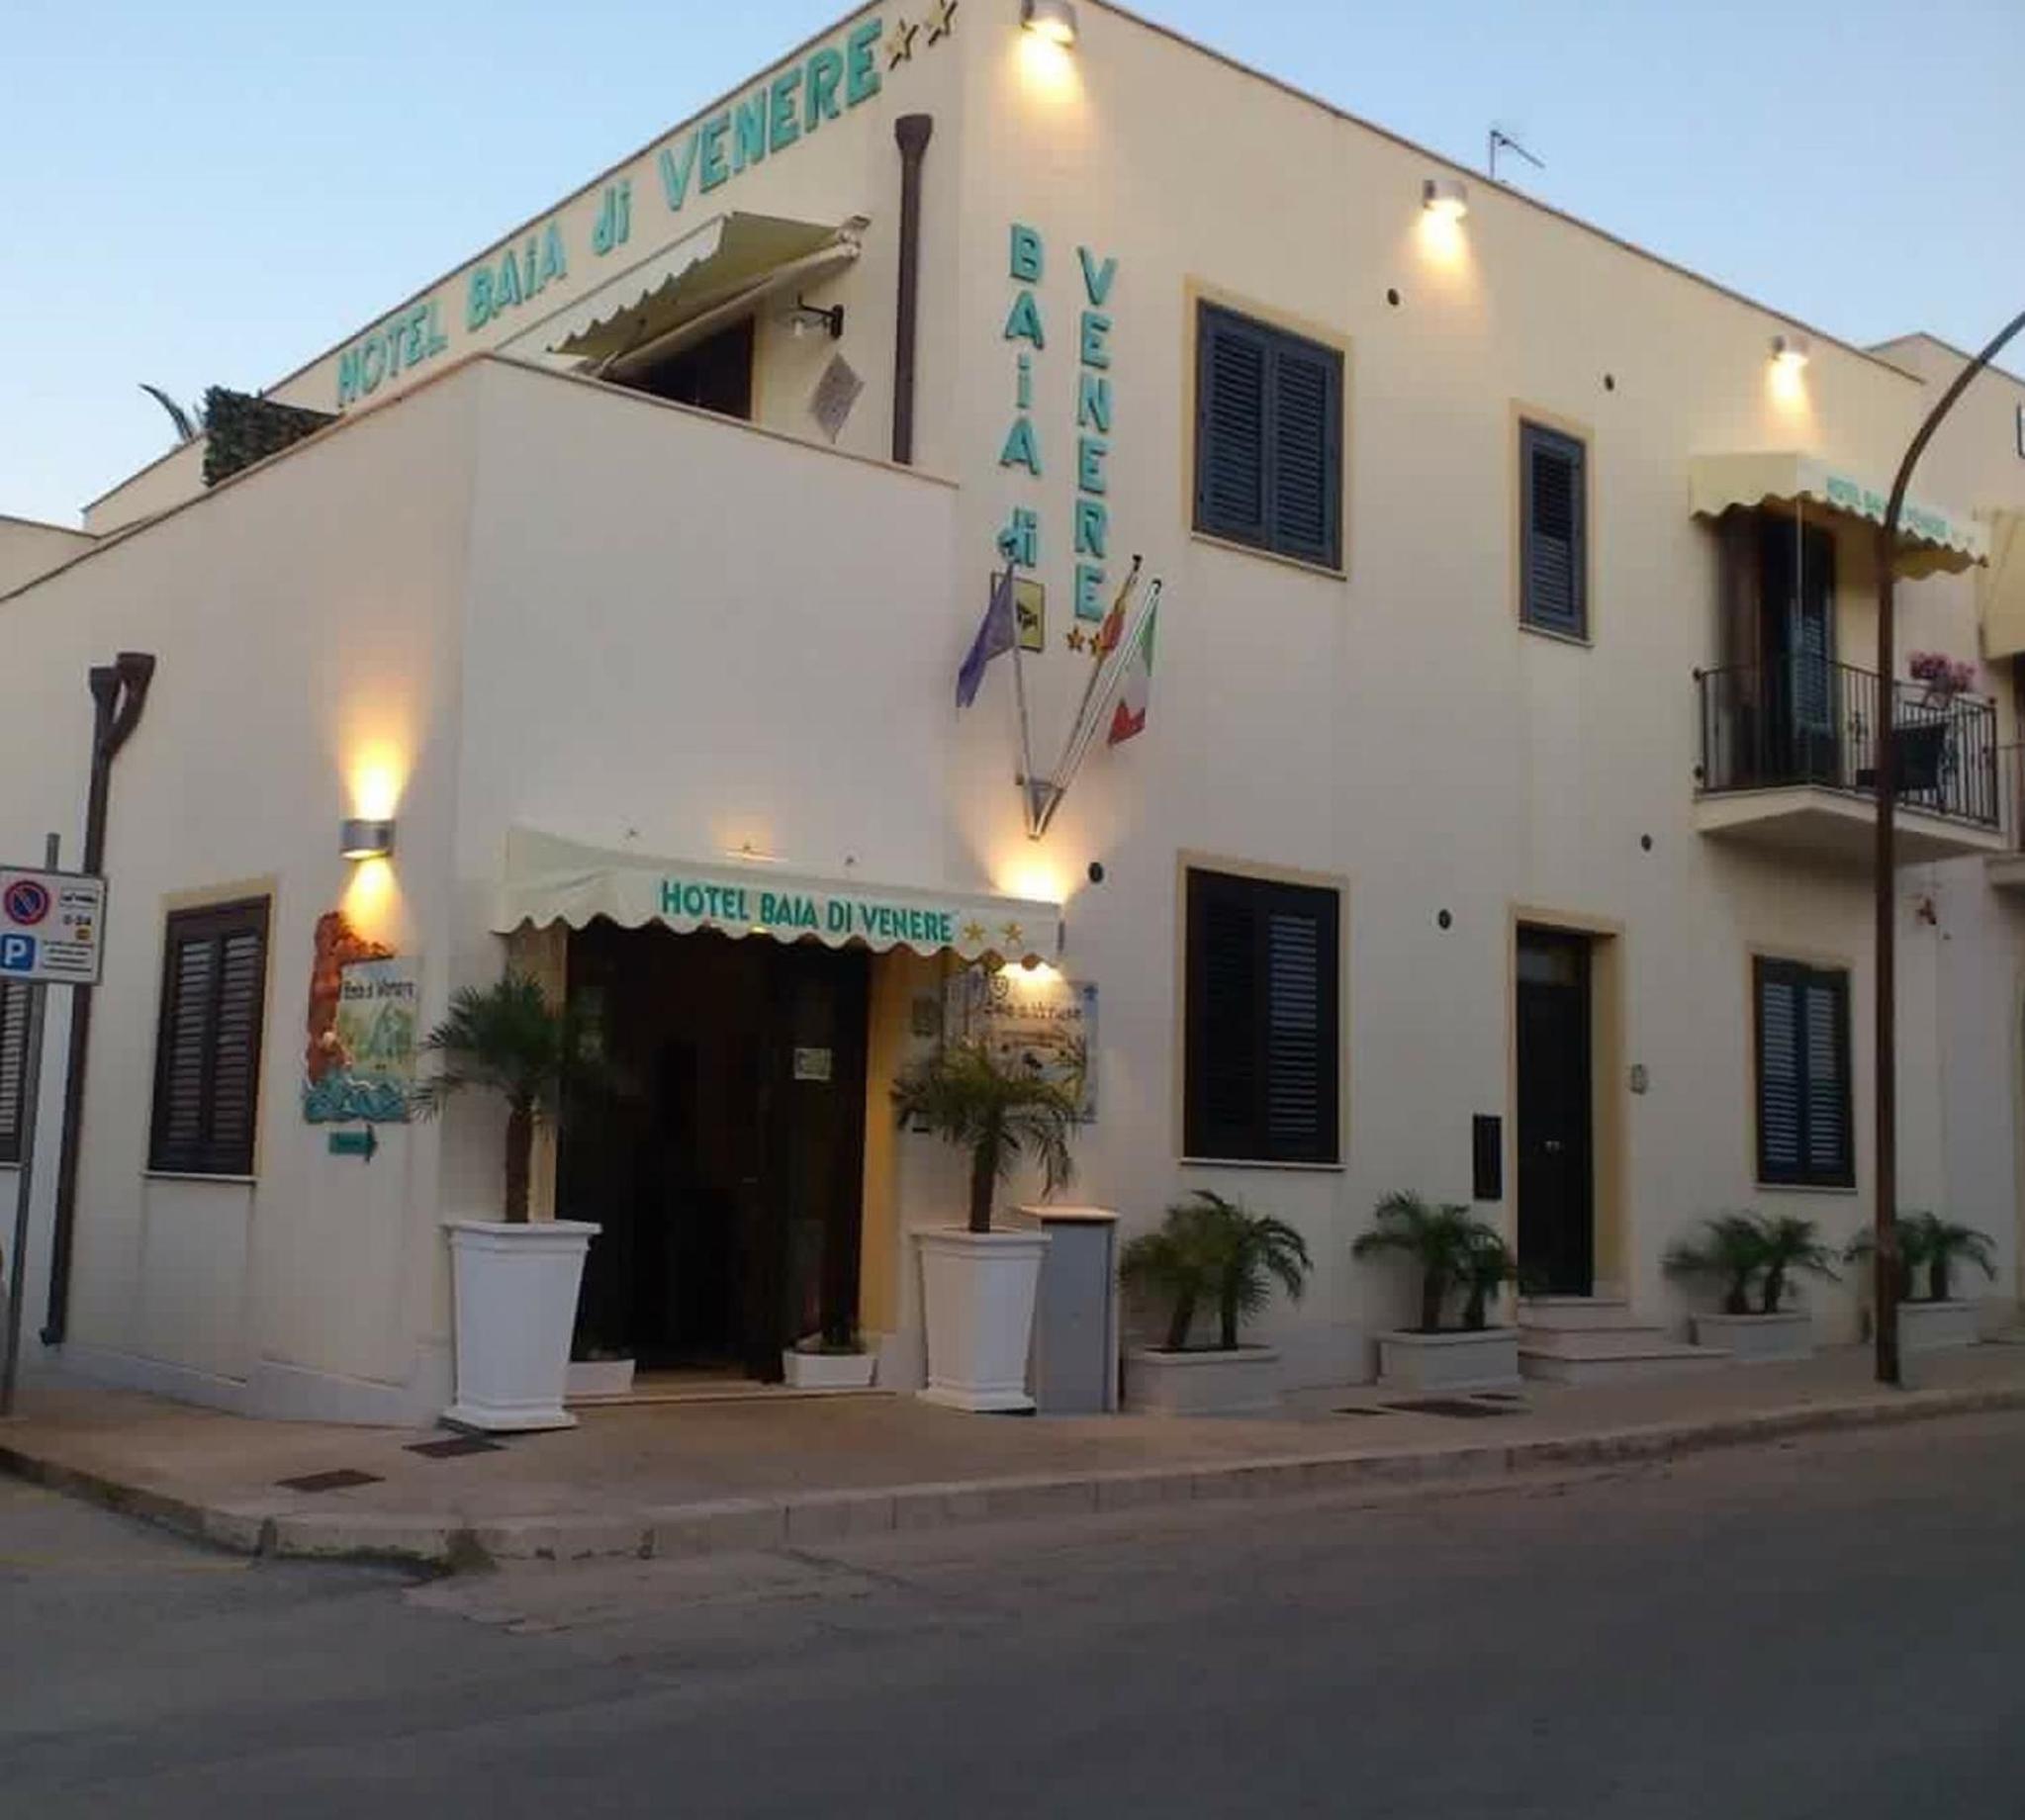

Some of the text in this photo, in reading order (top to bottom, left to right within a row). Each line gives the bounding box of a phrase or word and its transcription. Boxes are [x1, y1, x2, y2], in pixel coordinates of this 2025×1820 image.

[336, 300, 447, 408] HOTEL
[594, 180, 631, 256] di
[658, 17, 882, 212] VENERE
[1074, 245, 1118, 623] VENERE
[4, 938, 27, 966] P
[662, 880, 956, 943] HOTEL BAIA DI VENERE
